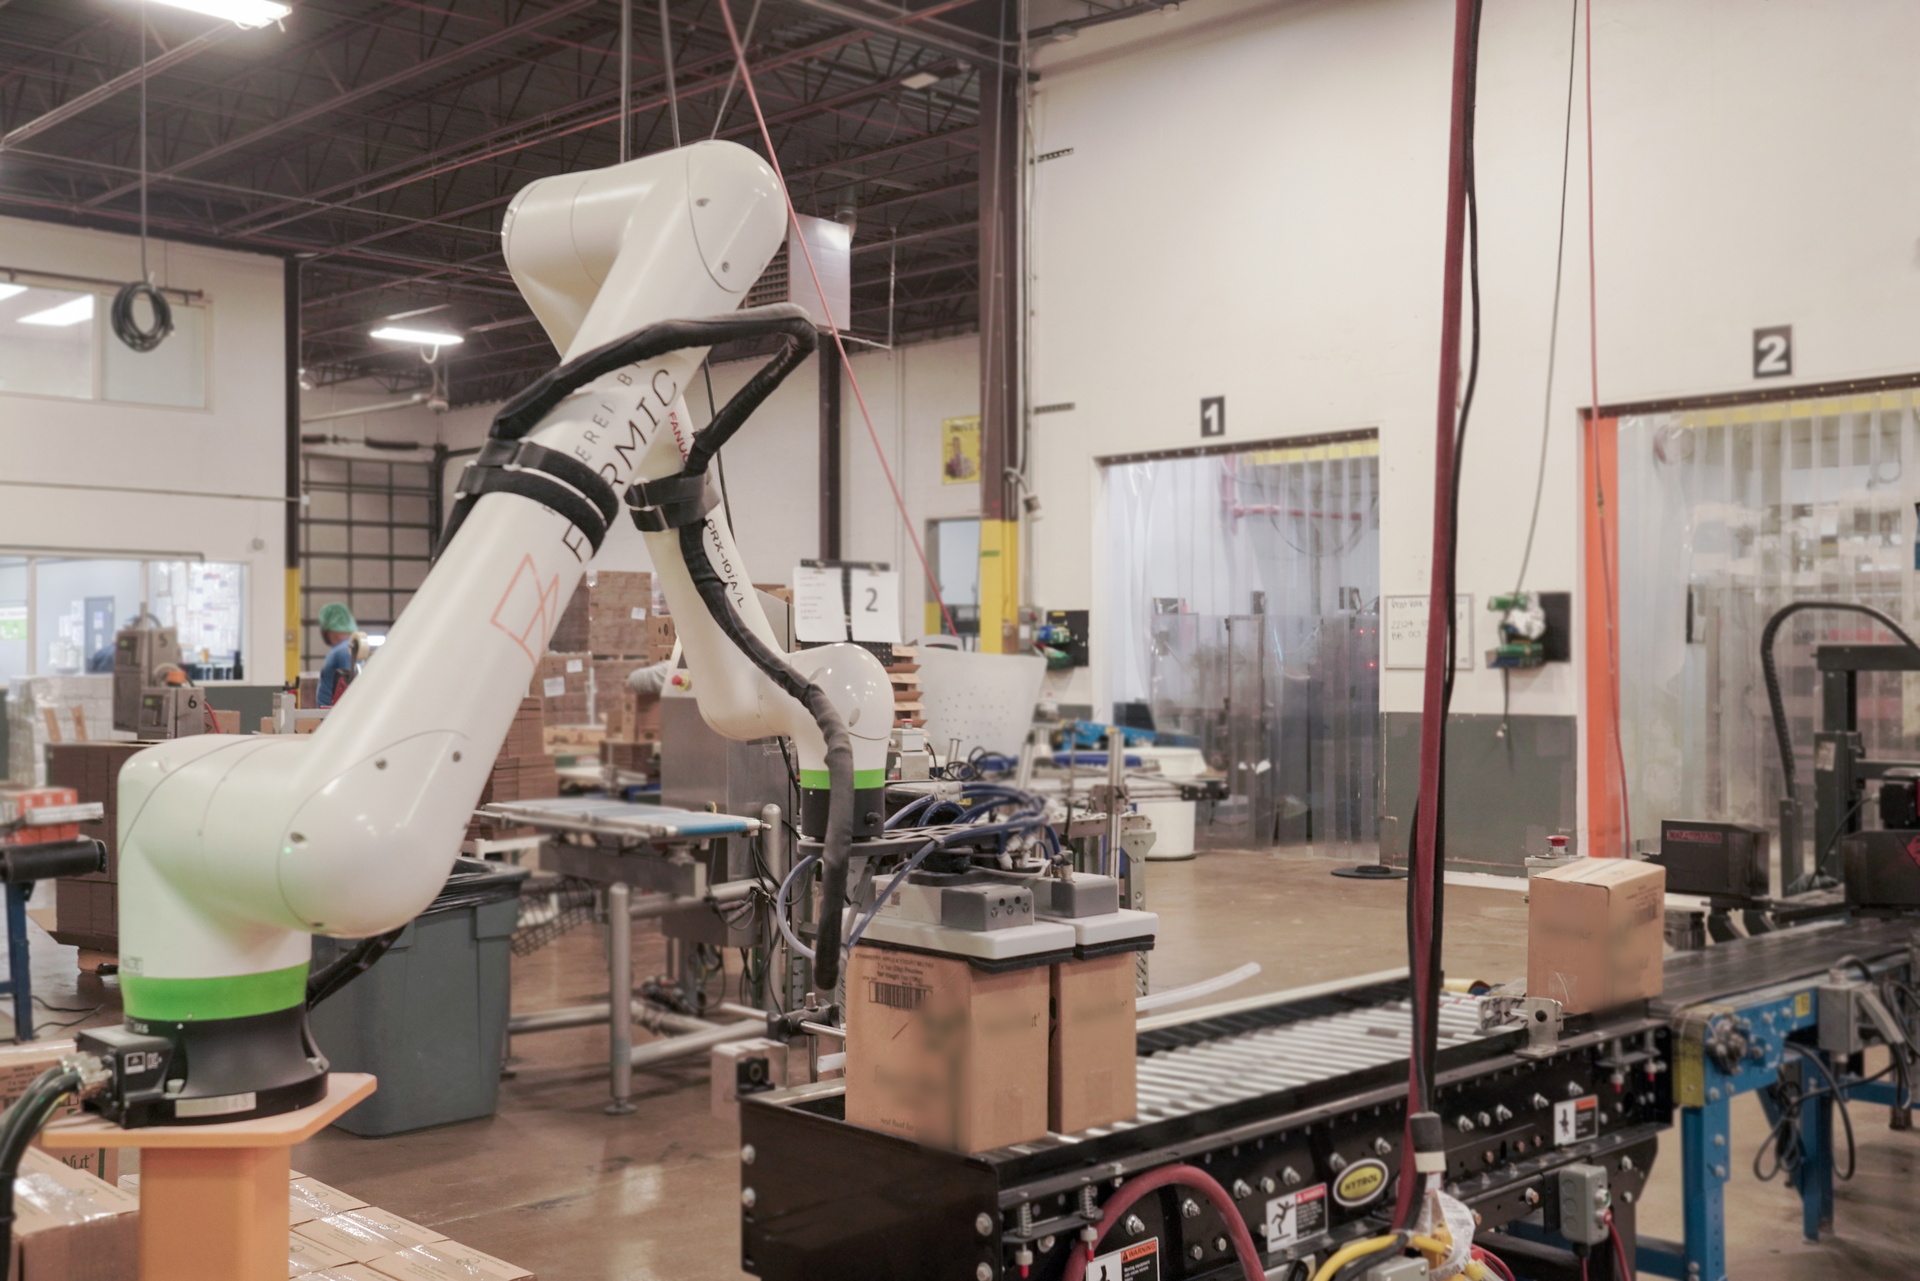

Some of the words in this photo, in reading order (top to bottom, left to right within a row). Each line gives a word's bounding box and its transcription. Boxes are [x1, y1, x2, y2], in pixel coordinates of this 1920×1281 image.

[1757, 334, 1787, 373] 2
[1204, 403, 1219, 433] 1
[668, 411, 688, 465] FANUC
[562, 368, 677, 564] FRMIC
[865, 587, 879, 612] 2
[158, 632, 168, 648] 5
[188, 695, 197, 709] 6
[1344, 1173, 1378, 1192] HYTROL
[1129, 1242, 1156, 1257] WARNING
